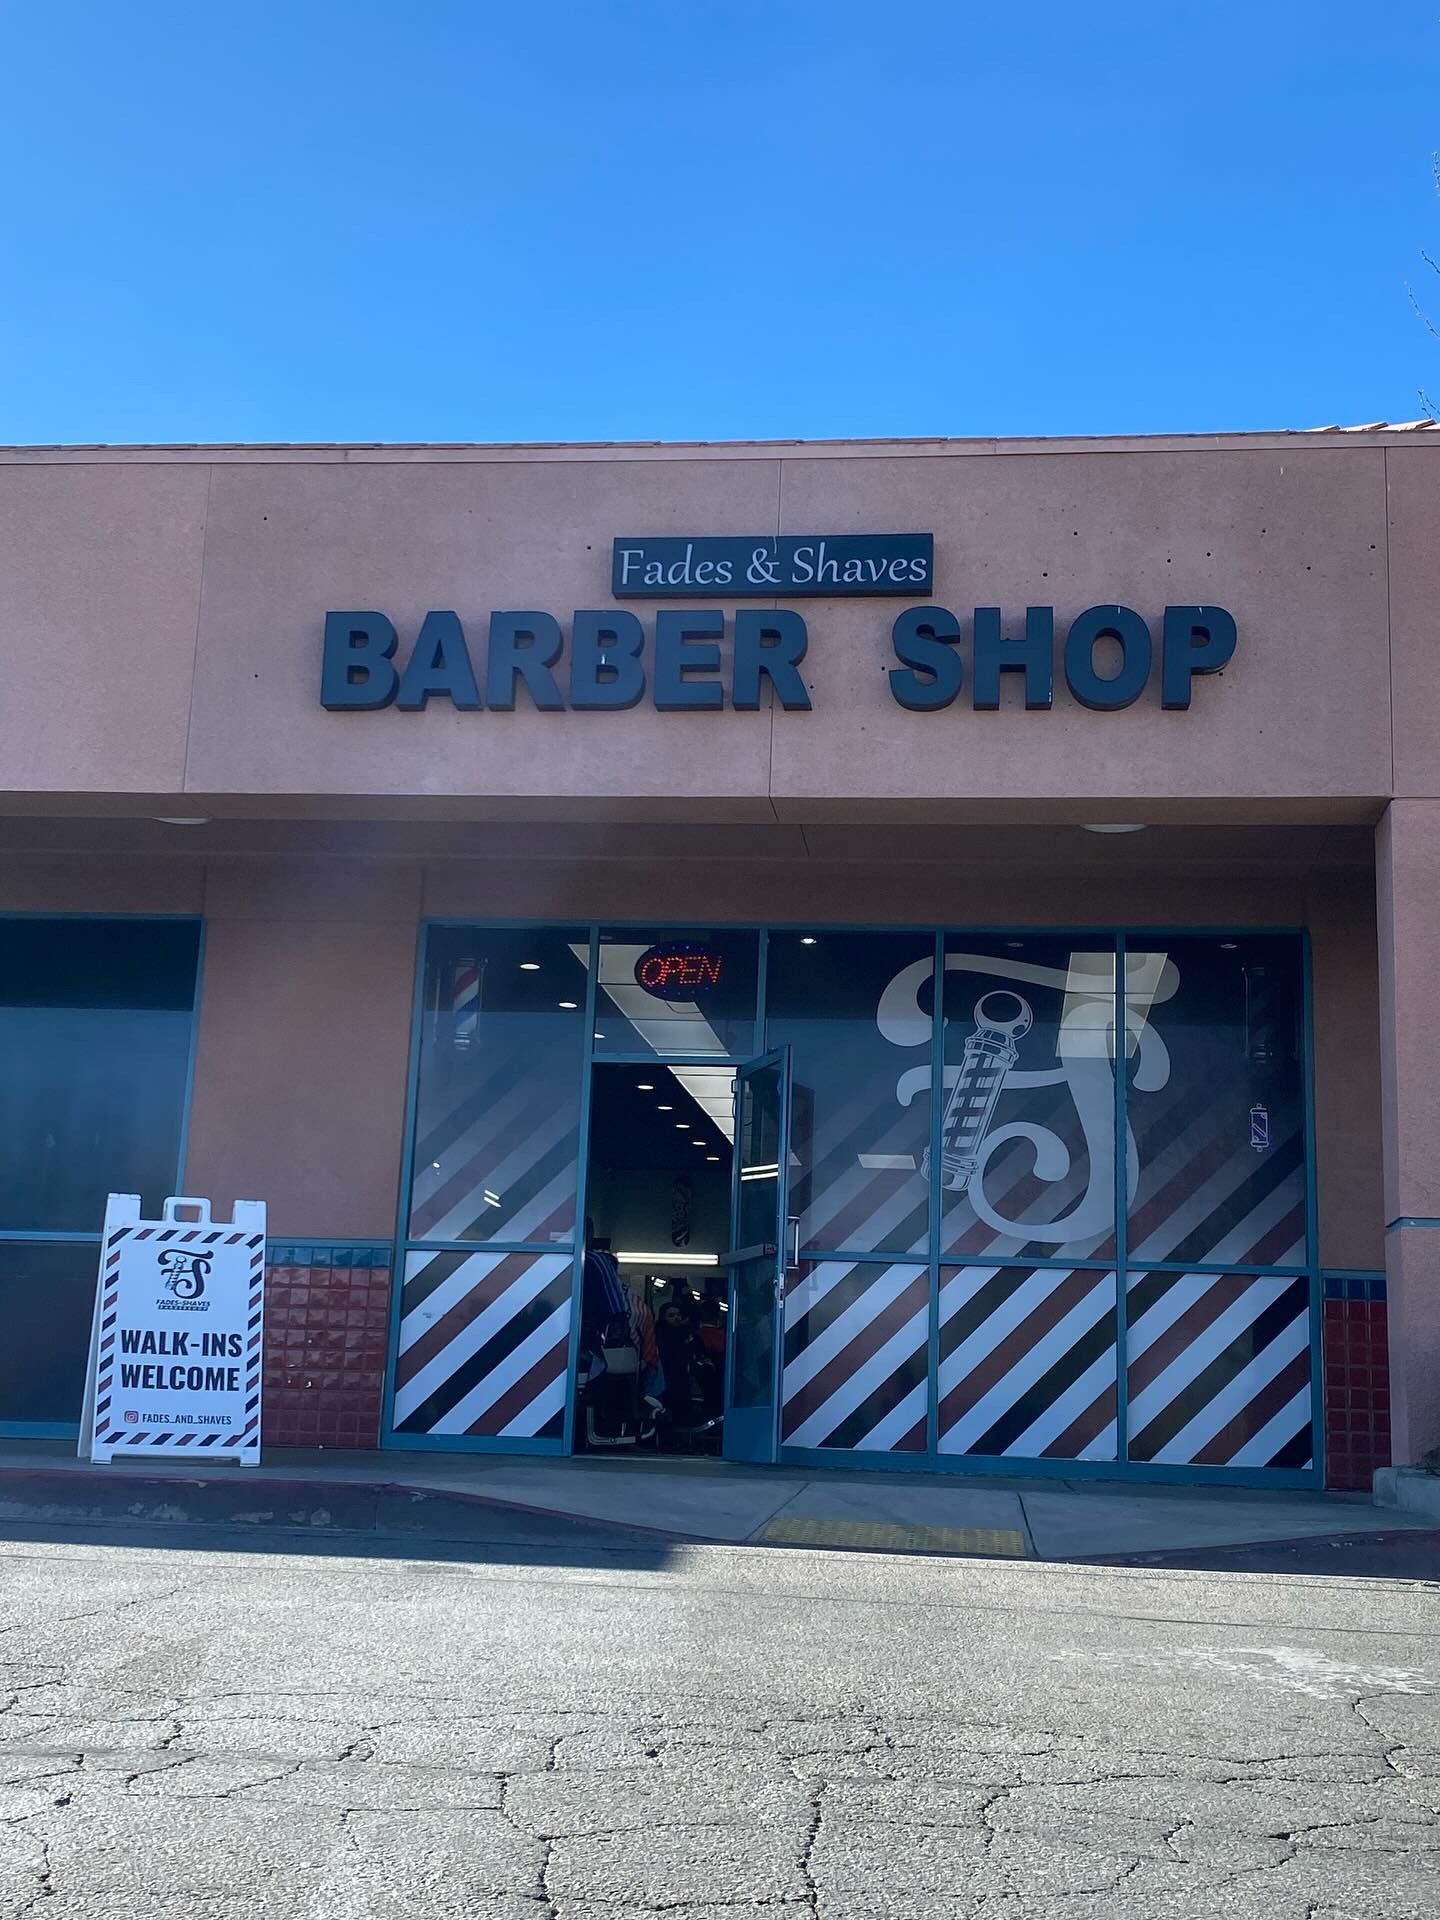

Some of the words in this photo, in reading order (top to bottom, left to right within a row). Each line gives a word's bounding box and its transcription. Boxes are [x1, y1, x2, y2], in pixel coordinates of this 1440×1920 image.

[619, 544, 733, 588] Fades
[745, 547, 782, 584] &
[791, 541, 929, 584] Shaves
[320, 610, 812, 712] BARBER
[889, 605, 1238, 711] SHOP
[641, 955, 722, 985] OPEN
[121, 1330, 243, 1357] WALK-INS
[121, 1364, 240, 1391] WELCOME
[142, 1413, 232, 1425] FADES_AND_SHAVES
